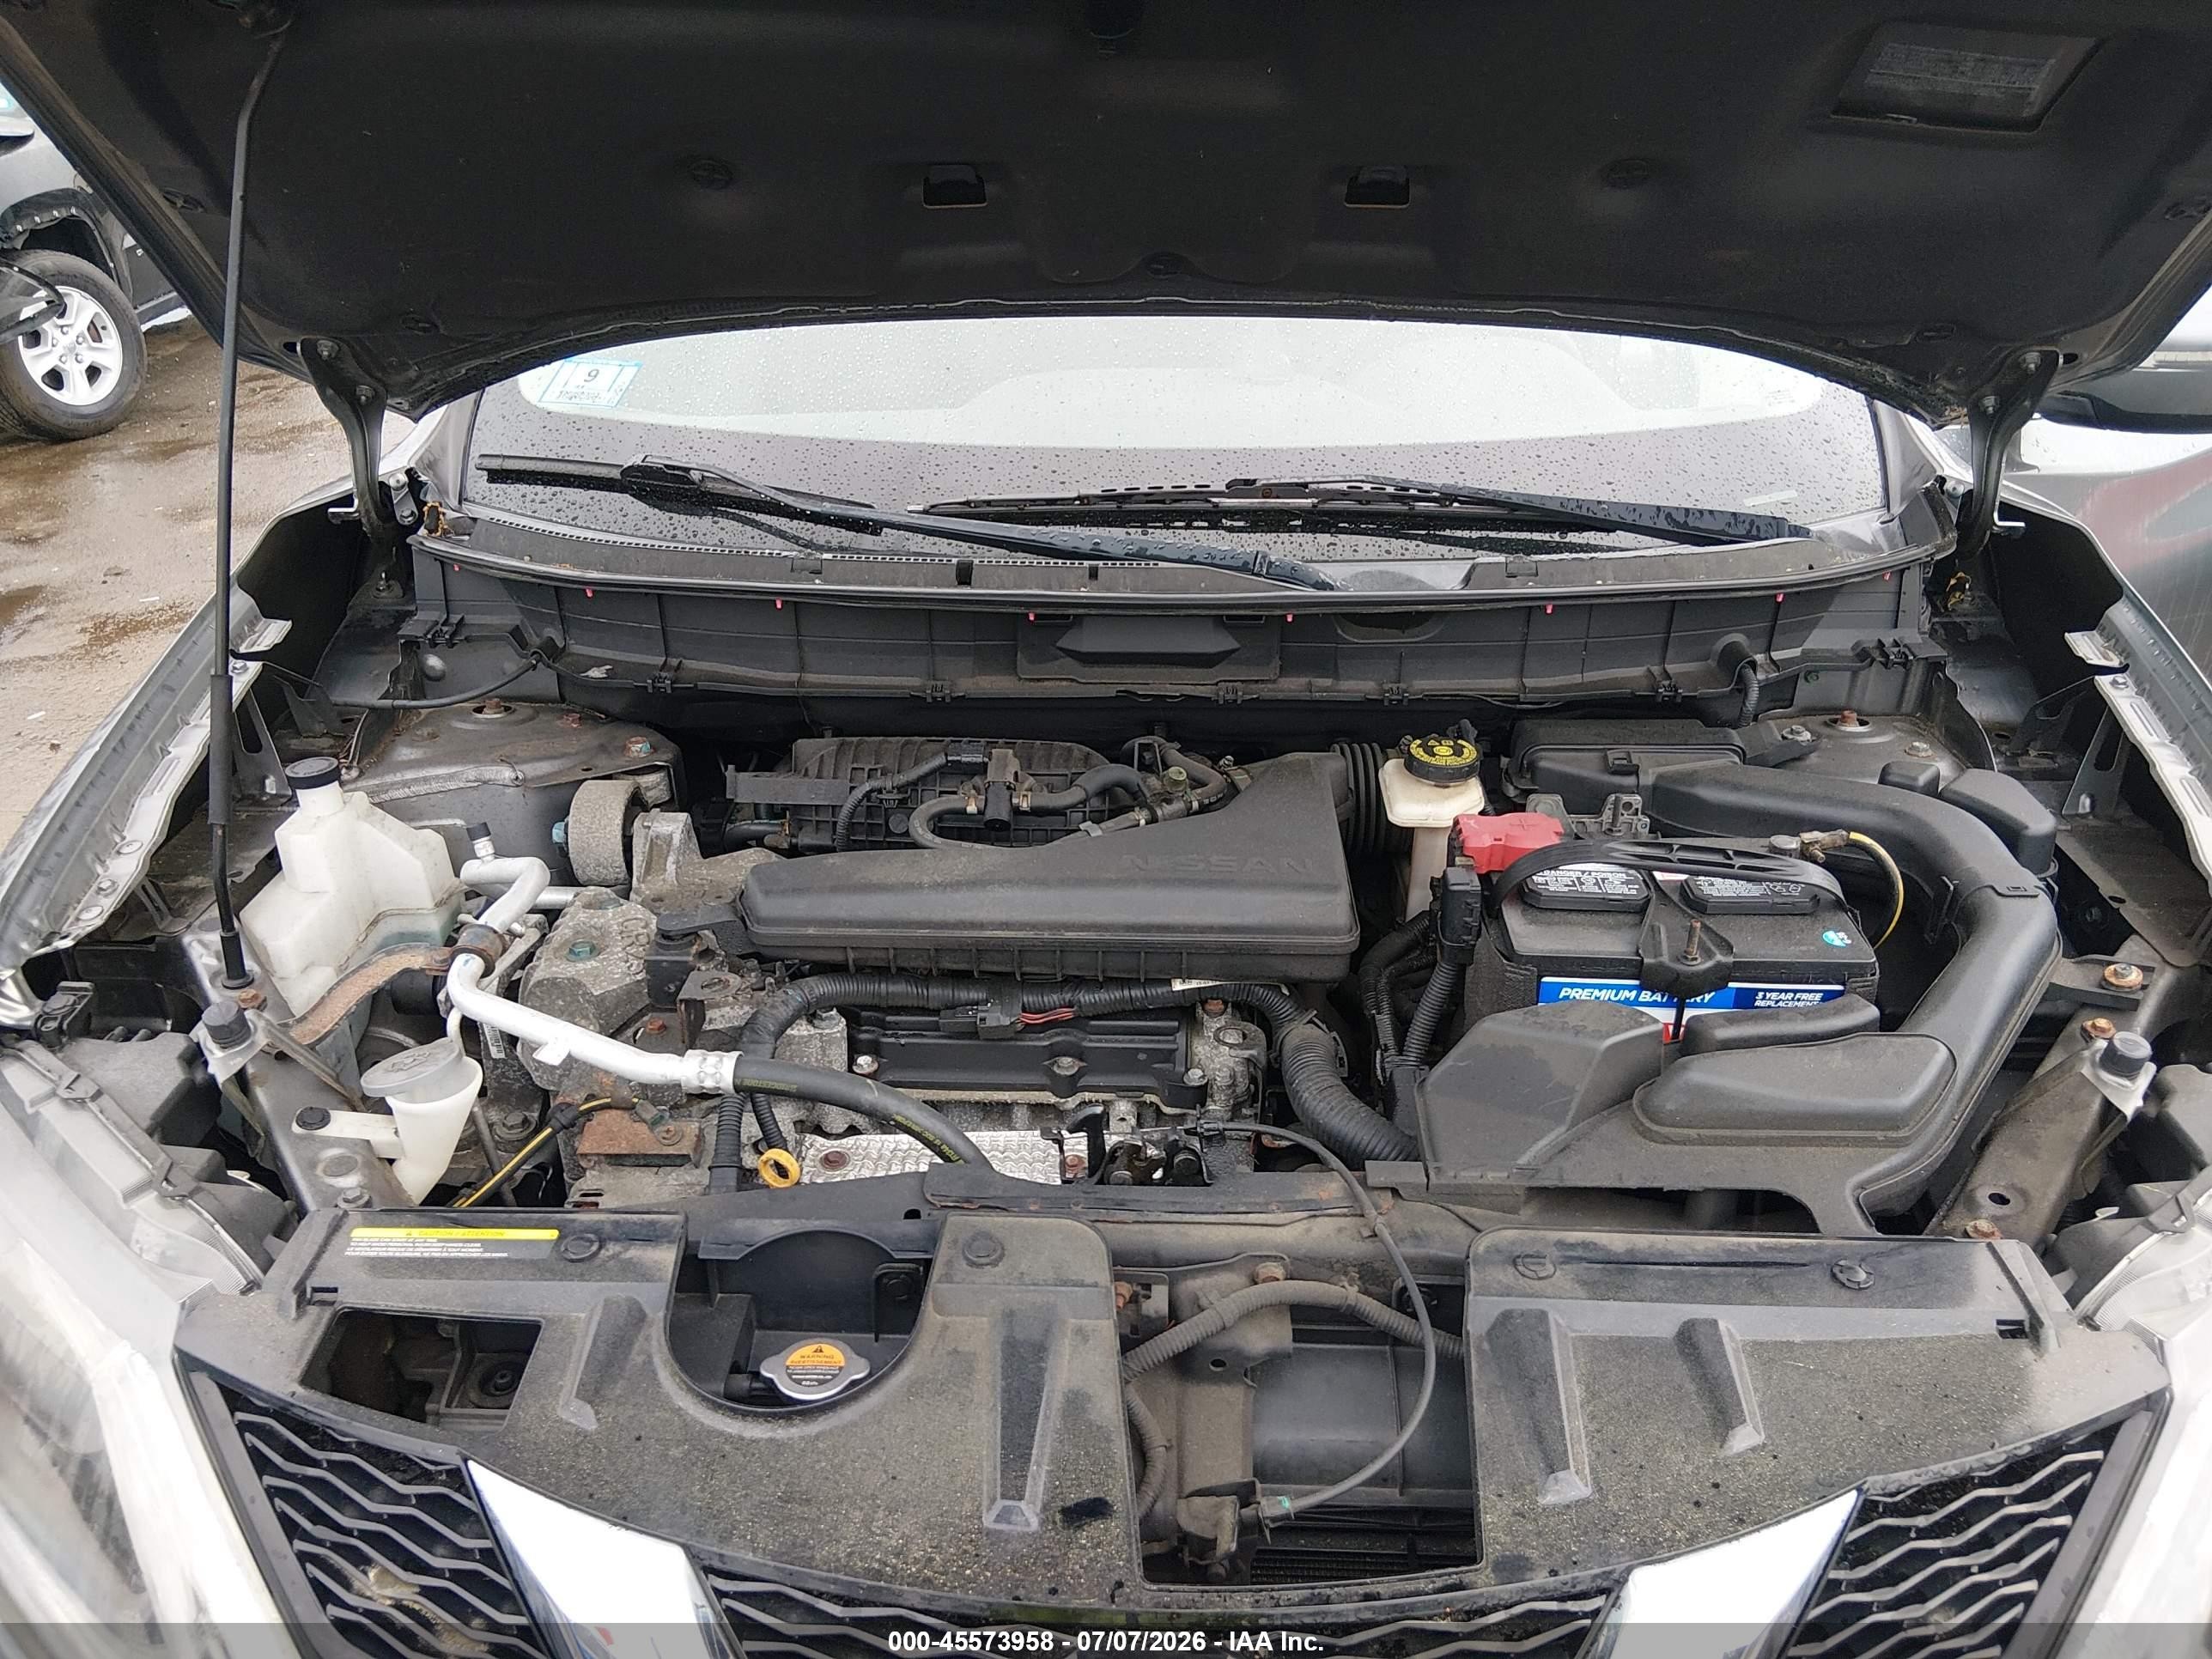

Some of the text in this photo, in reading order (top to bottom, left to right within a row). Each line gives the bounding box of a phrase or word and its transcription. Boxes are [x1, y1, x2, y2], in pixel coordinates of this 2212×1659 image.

[584, 368, 599, 382] 9
[1122, 854, 1313, 874] NISSAN
[1559, 987, 1716, 1003] PREMIUM BATRY
[1765, 992, 1795, 1000] YEAR
[1794, 993, 1824, 1001] FREE
